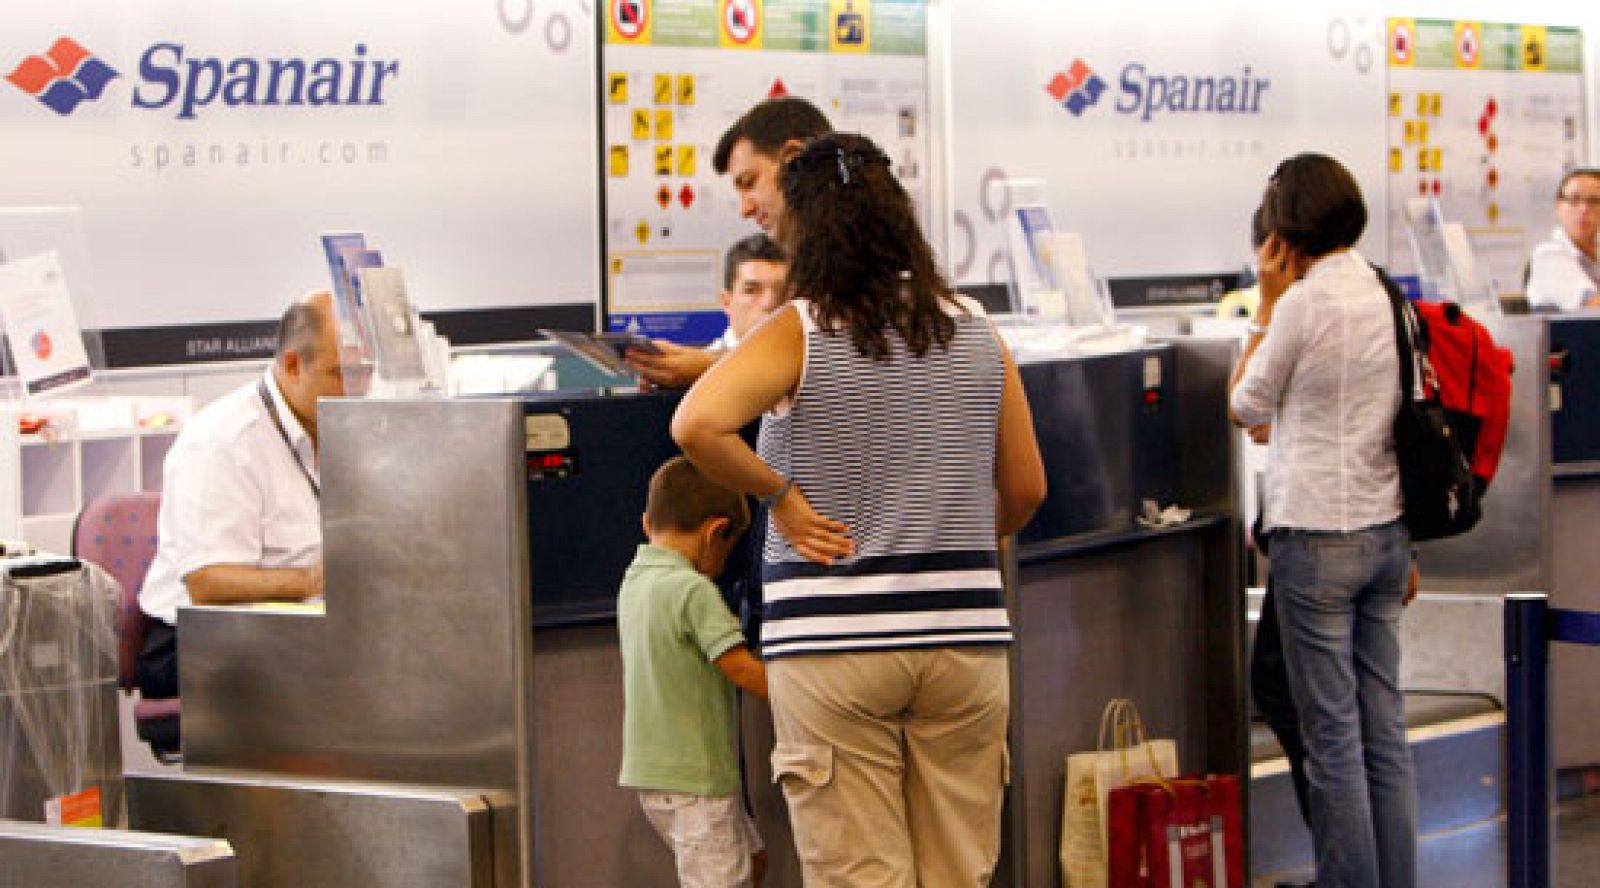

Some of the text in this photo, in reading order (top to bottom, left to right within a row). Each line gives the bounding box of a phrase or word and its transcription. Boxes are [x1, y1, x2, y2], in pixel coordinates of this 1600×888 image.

[131, 44, 399, 119] Spanair
[1115, 63, 1270, 121] Spanair
[130, 143, 388, 169] spanair.com
[226, 336, 279, 352] ALLIAN
